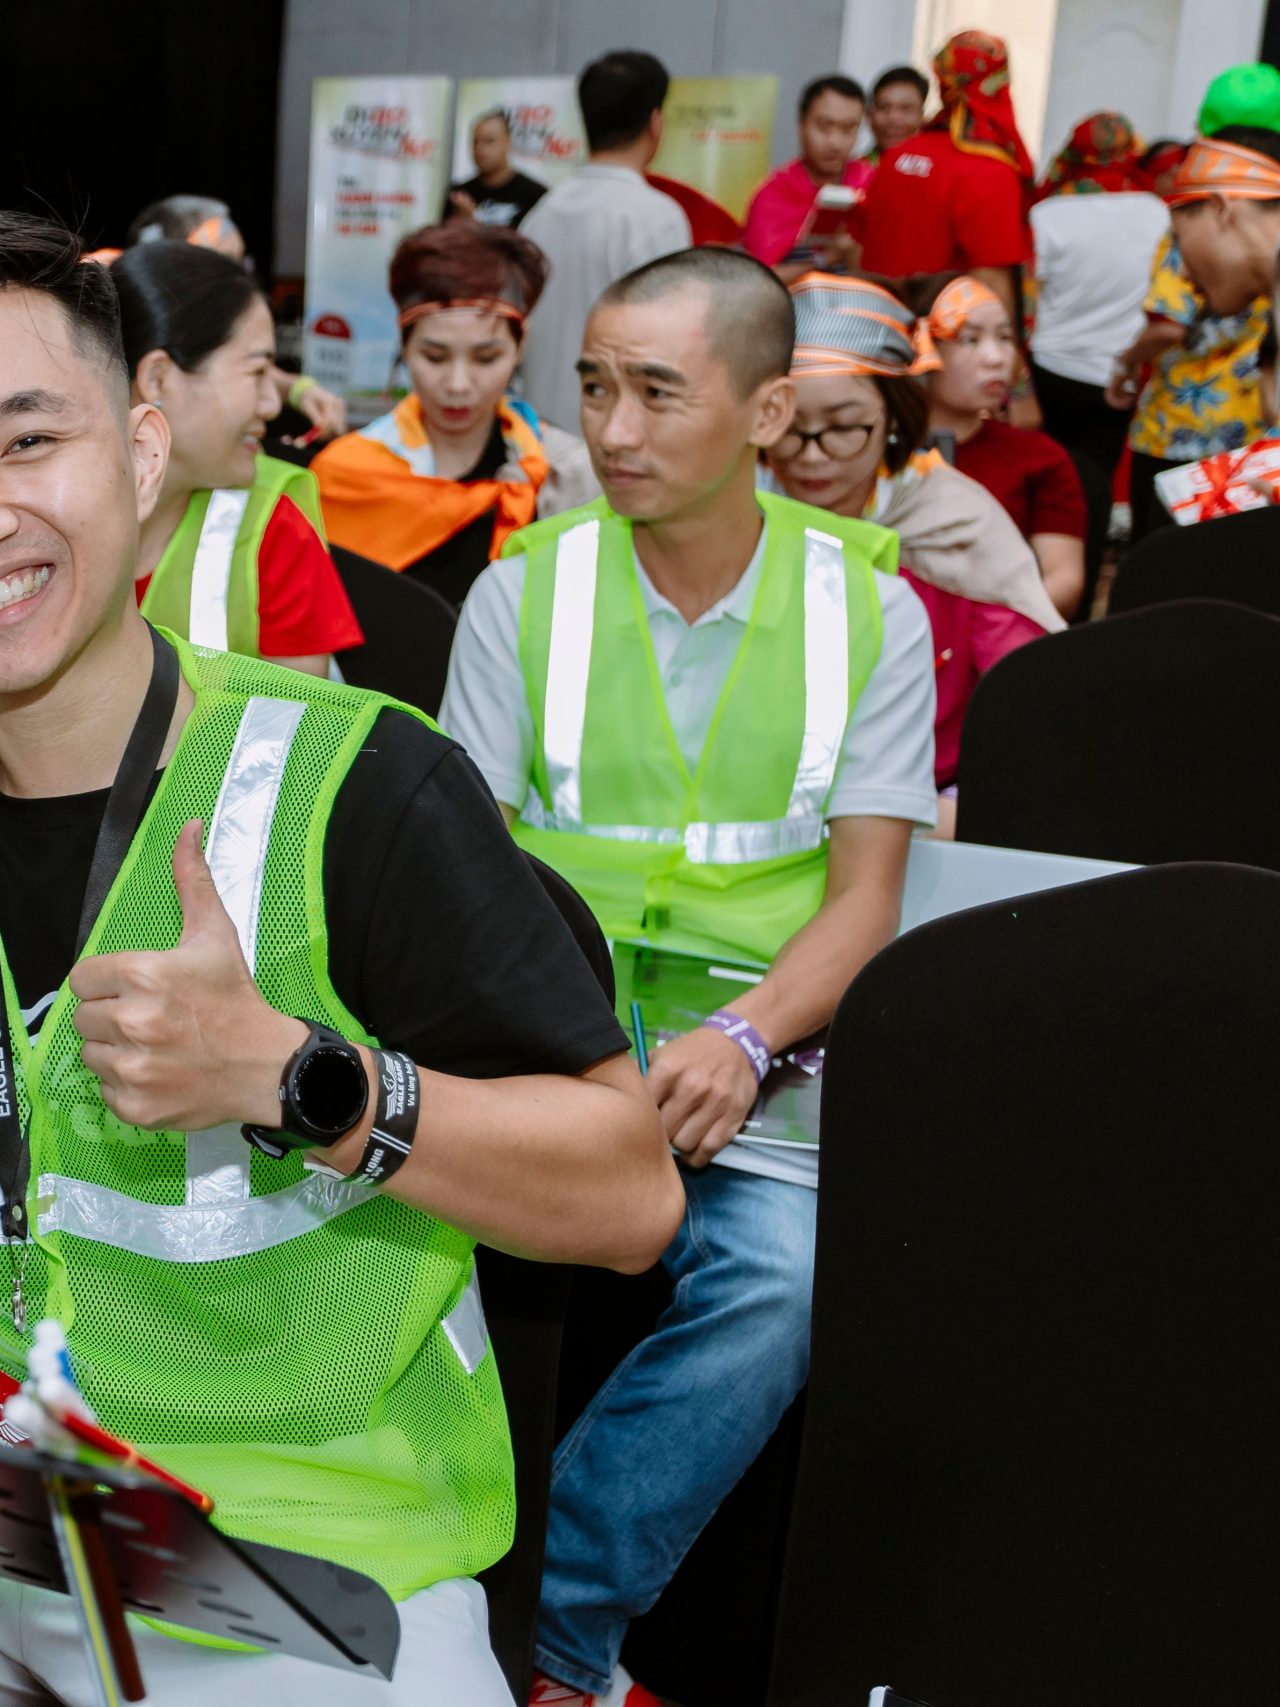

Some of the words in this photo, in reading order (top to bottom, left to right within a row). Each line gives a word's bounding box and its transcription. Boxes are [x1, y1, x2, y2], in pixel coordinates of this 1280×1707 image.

[394, 1060, 404, 1083] CAMP
[396, 1084, 405, 1115] EAGLE
[366, 1148, 384, 1172] LONG
